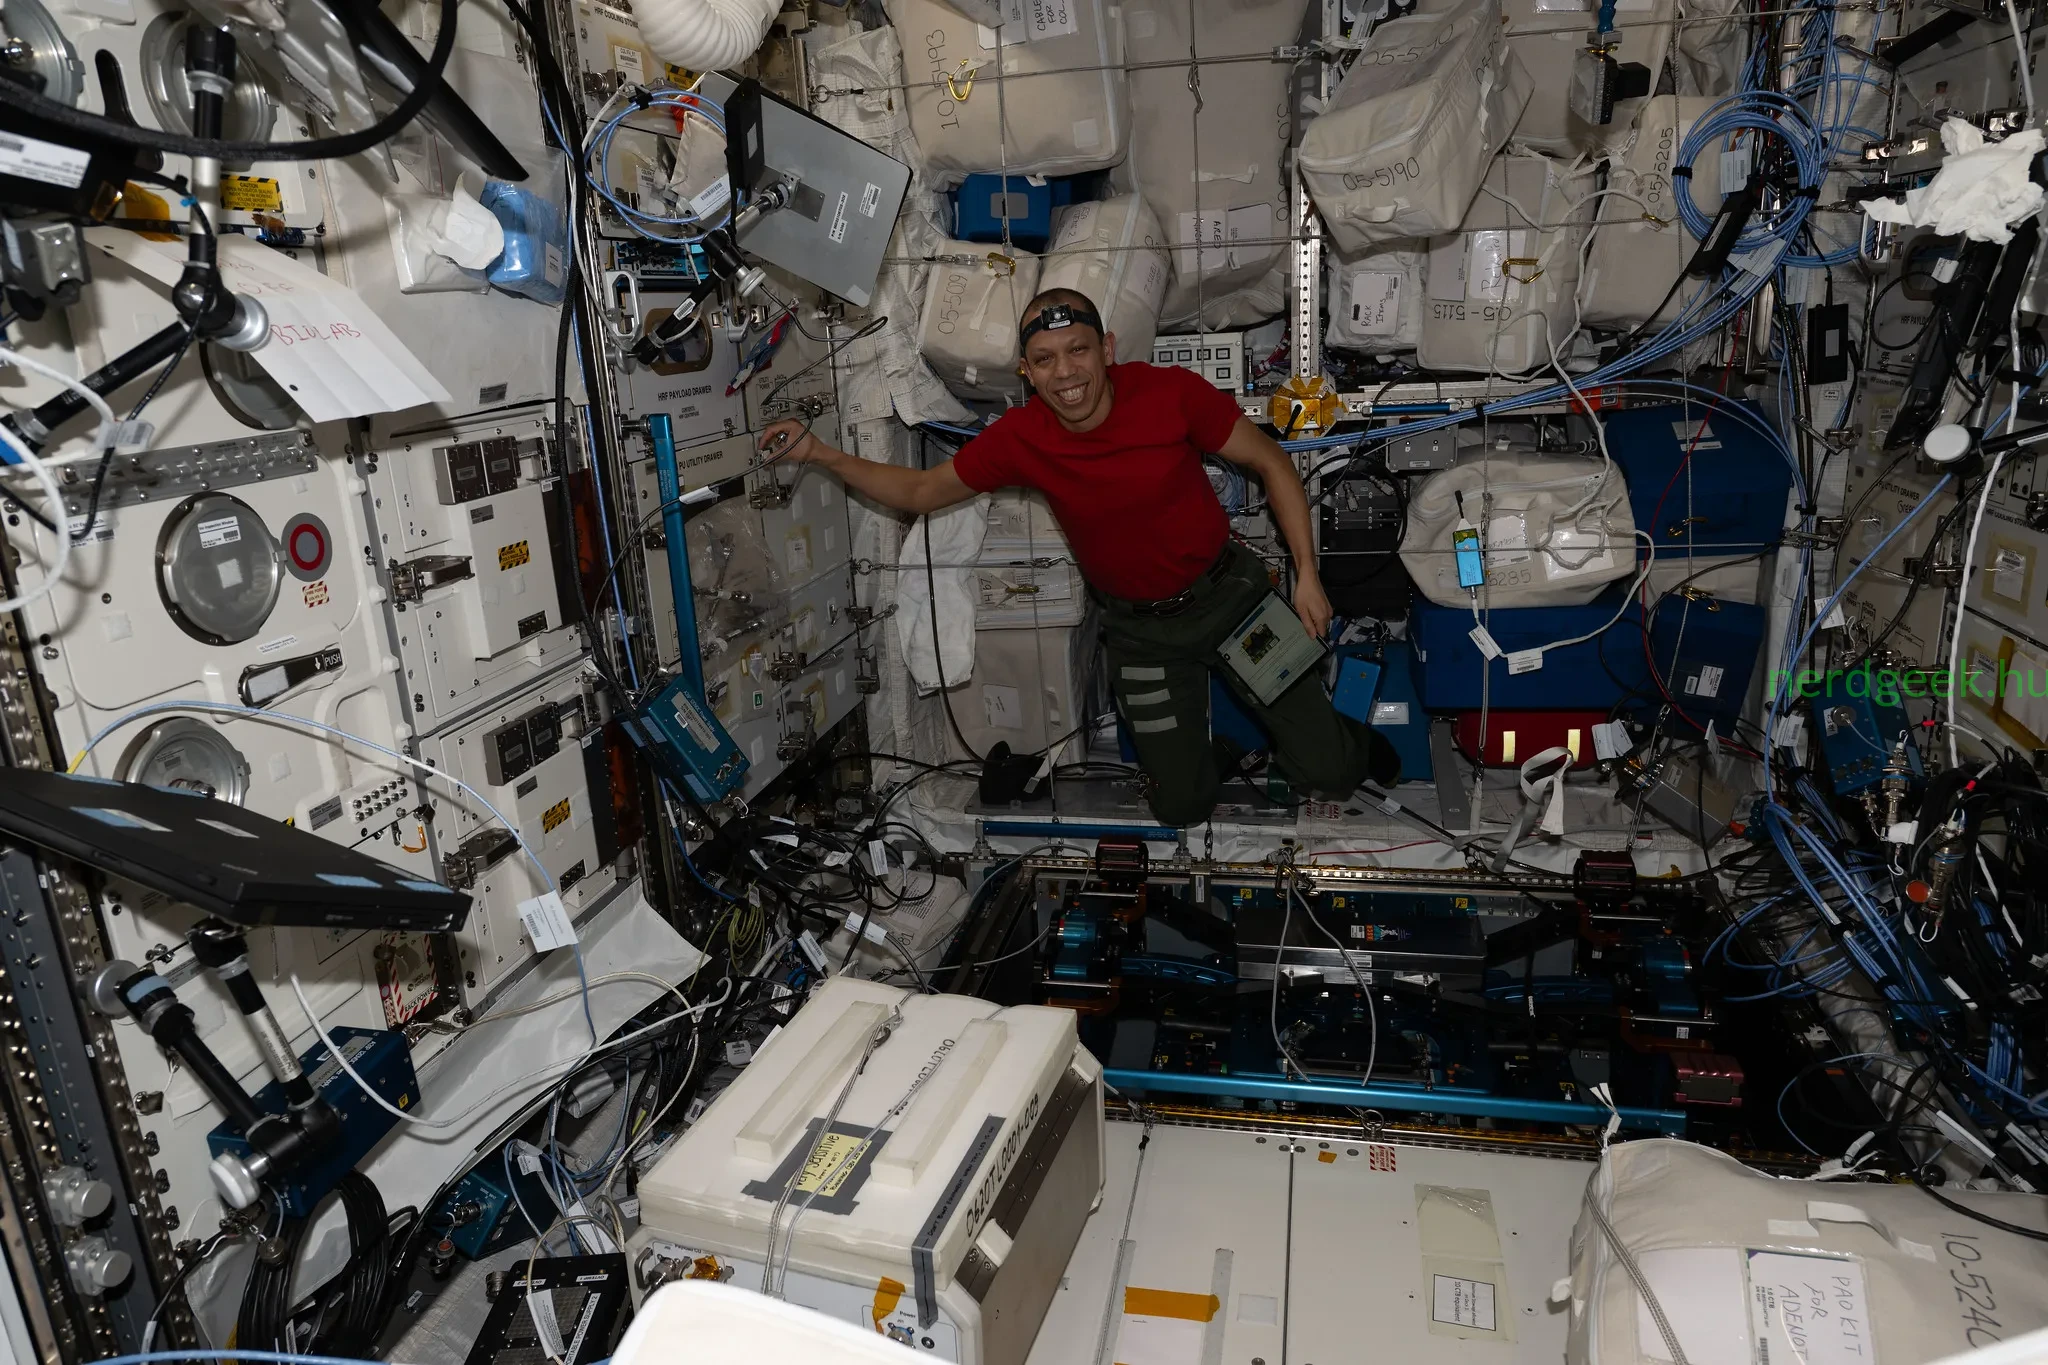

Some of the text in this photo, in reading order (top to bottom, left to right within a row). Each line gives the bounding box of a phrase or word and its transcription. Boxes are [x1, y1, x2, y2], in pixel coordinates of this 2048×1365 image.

[604, 10, 622, 24] COOLING
[1046, 5, 1056, 24] FOR
[1361, 305, 1372, 327] RACK
[657, 385, 712, 402] HRF PAYLOAD DRAWER
[686, 455, 703, 468] UTILITY
[703, 451, 723, 463] DRAWER
[1900, 487, 1920, 501] DRAWER
[325, 652, 342, 667] PUSH
[405, 1001, 417, 1012] RACK
[575, 1315, 587, 1339] POWER
[585, 1299, 596, 1319] SUPPLY
[1842, 1316, 1863, 1356] KIT
